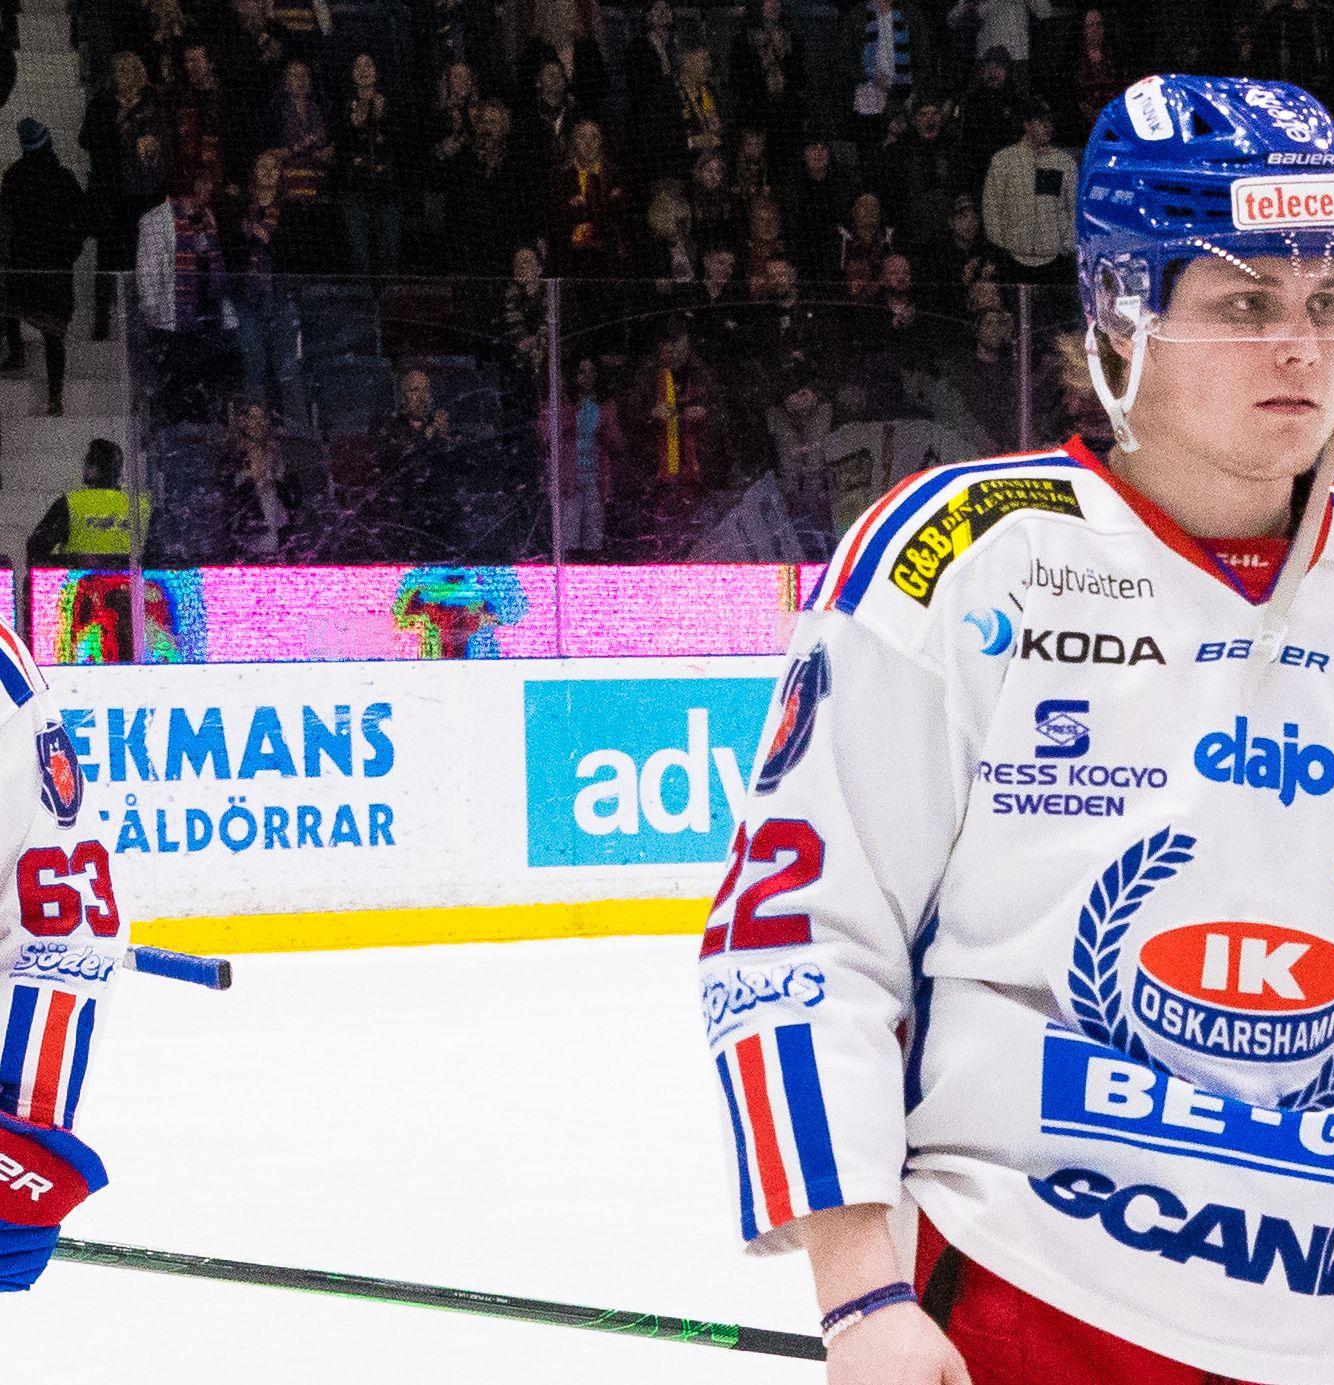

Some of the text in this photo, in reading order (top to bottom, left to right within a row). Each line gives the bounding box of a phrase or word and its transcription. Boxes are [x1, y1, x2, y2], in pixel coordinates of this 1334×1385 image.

[893, 526, 953, 598] G&B
[1026, 558, 1154, 600] bytvätten
[1012, 628, 1167, 666] KODA
[1195, 639, 1330, 673] BAER
[1069, 764, 1168, 788] KOGYO
[993, 793, 1125, 816] SWEDEN
[17, 839, 120, 939] 63
[1201, 933, 1311, 1000] IK
